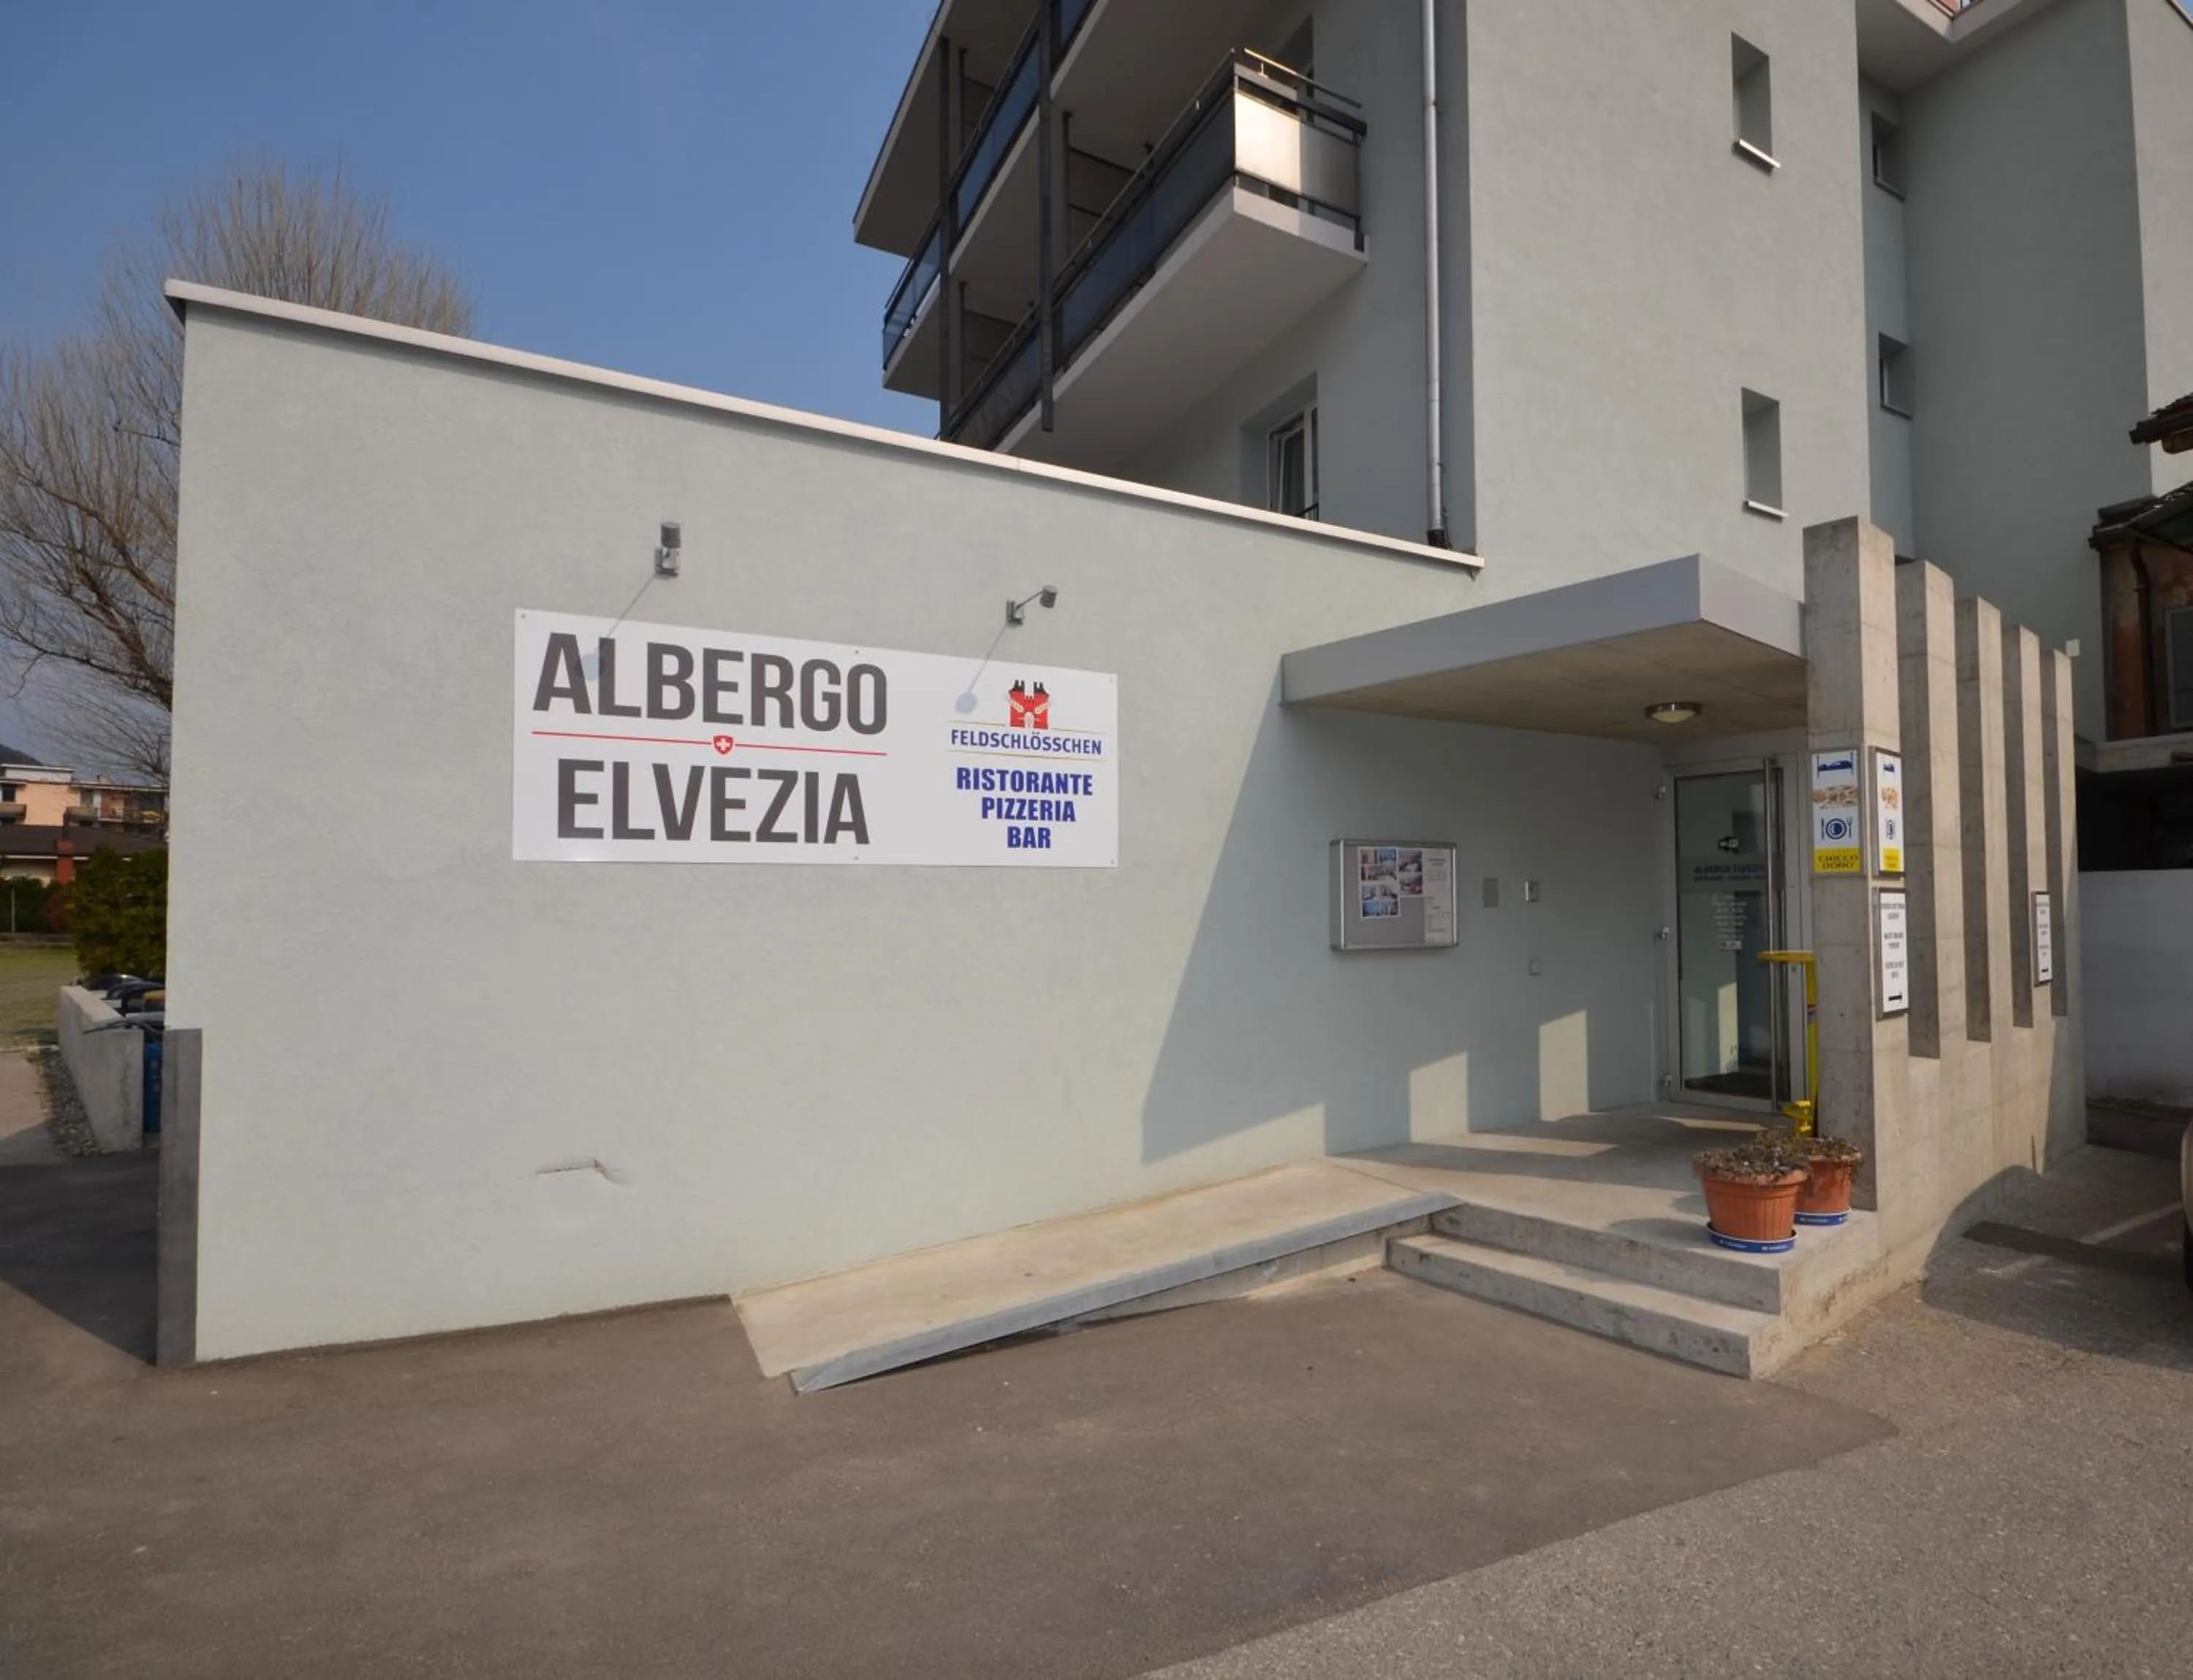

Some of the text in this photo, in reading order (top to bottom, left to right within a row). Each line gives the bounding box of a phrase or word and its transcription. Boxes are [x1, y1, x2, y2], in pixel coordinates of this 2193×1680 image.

[533, 632, 887, 735] ALBERGO
[950, 728, 1102, 756] FELDSCHLÖSSCHEN
[956, 767, 1094, 796] RISTORANTE
[557, 759, 870, 845] ELVEZIA
[981, 797, 1077, 822] PIZZERIA
[1007, 826, 1051, 849] BAR
